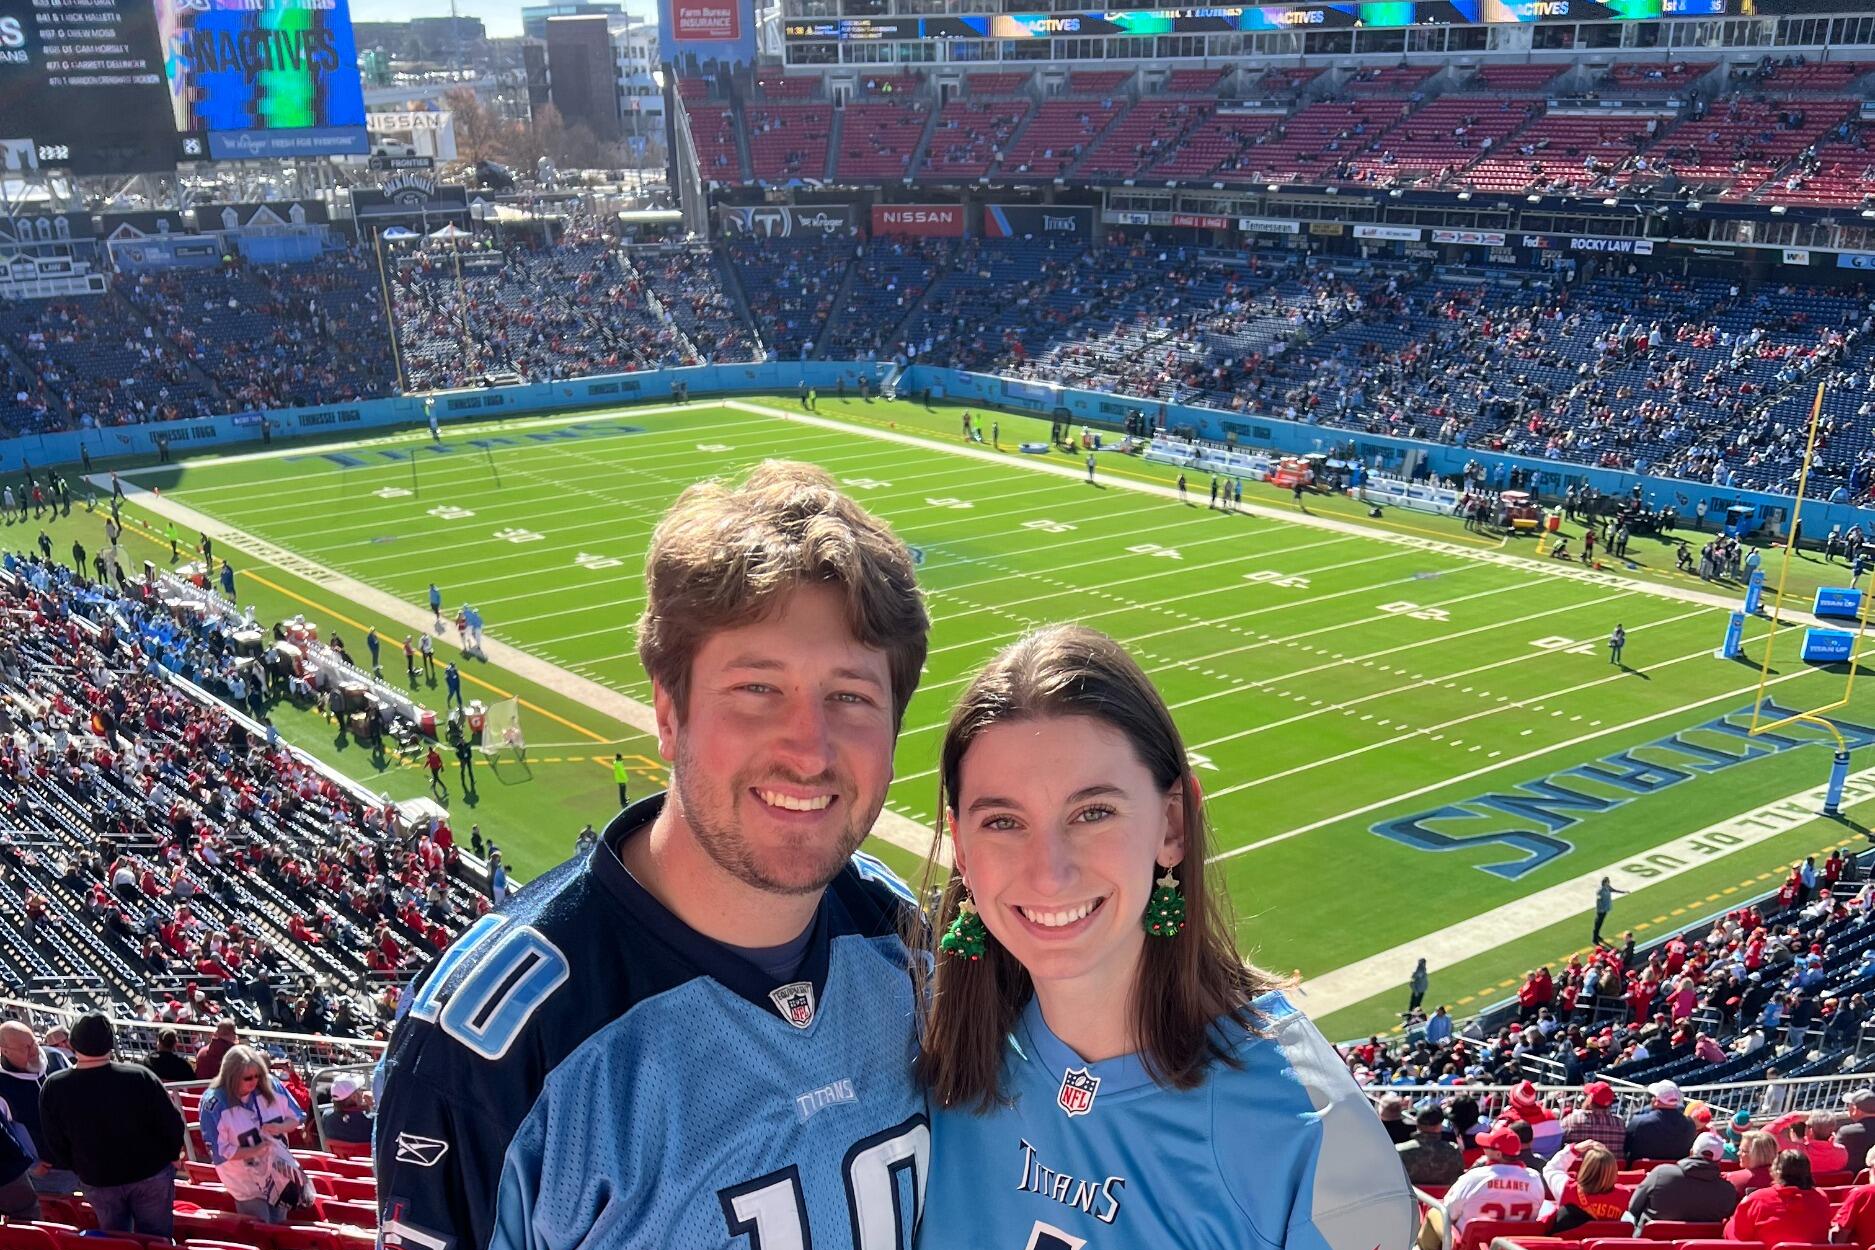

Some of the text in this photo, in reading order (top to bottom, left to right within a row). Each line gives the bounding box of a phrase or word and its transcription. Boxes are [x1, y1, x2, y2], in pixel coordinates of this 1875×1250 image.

[680, 18, 731, 28] INSURANCE
[883, 212, 953, 223] NISSAN
[1522, 235, 1550, 248] FedEx
[1570, 238, 1632, 252] ROCKY LAW
[1810, 645, 1835, 653] TITAN
[1620, 802, 1817, 878] ALL OF US
[409, 913, 570, 1060] 10
[792, 1005, 812, 1021] NFL
[796, 1079, 854, 1117] TITANS
[1062, 1085, 1088, 1109] NFL
